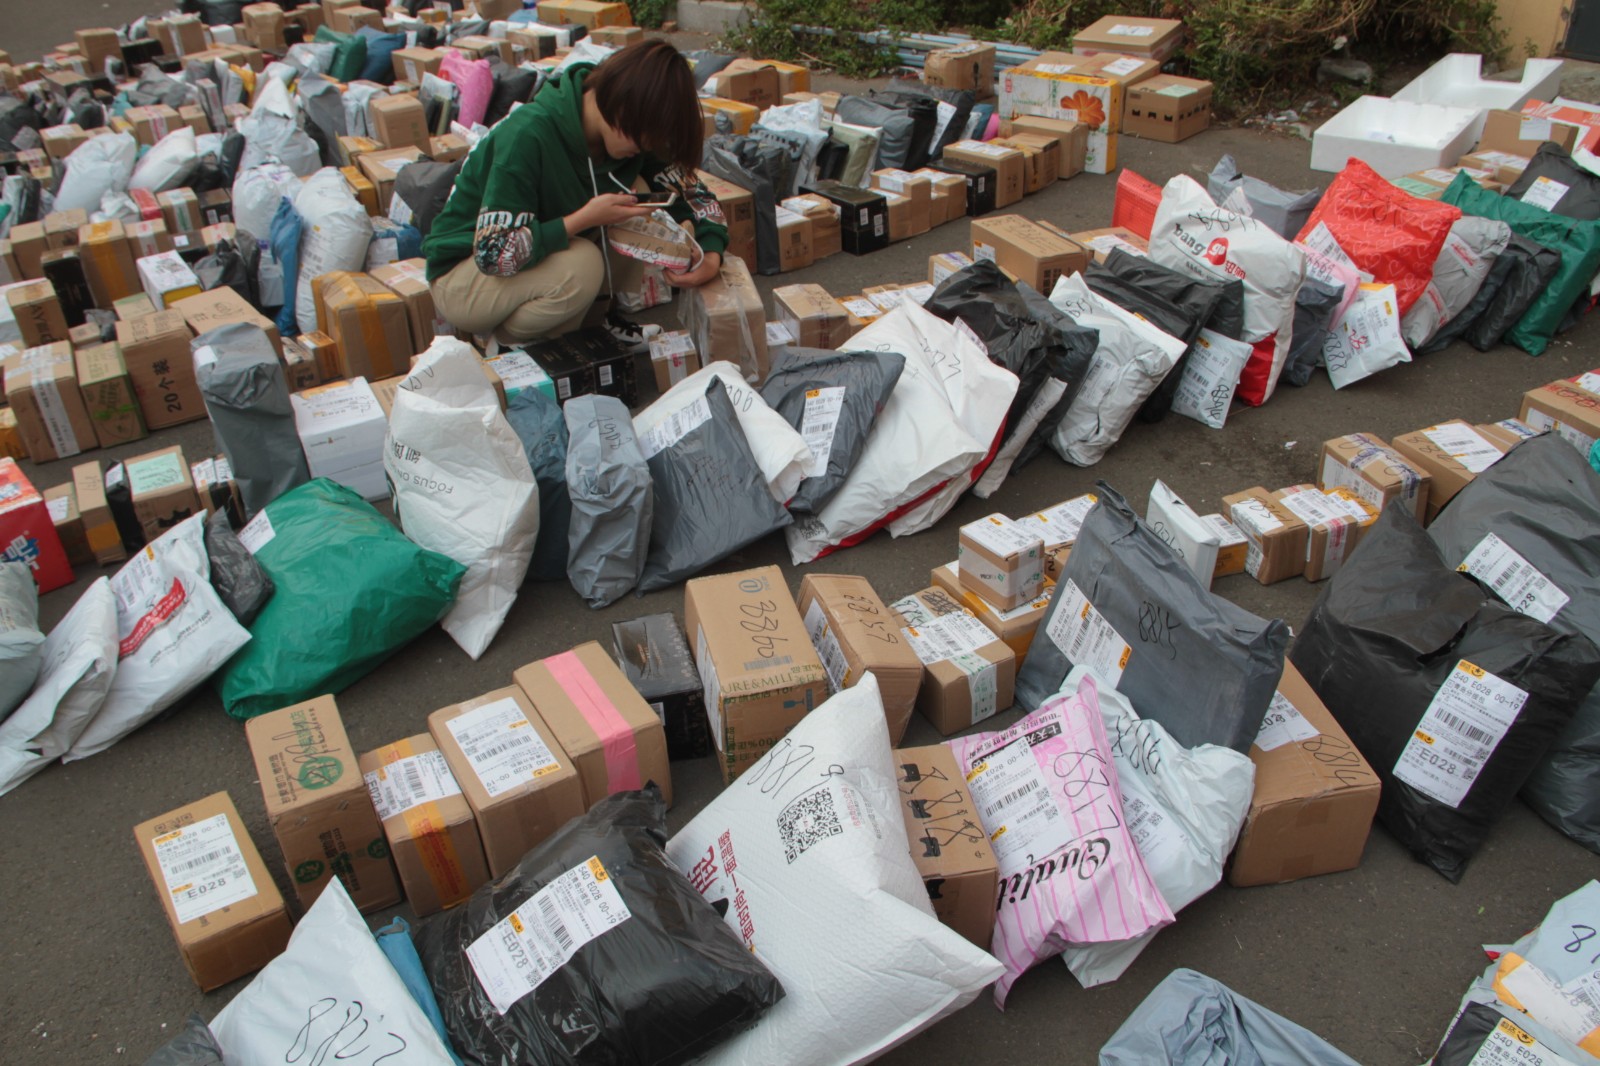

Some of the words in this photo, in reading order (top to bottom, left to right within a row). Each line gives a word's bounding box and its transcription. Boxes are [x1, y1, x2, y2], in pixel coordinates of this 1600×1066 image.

[1173, 222, 1206, 256] bang
[413, 475, 454, 494] FOCUS
[1515, 592, 1536, 614] 028
[1453, 672, 1470, 684] 540
[1471, 681, 1491, 696] E028
[1494, 692, 1520, 710] 00-19
[985, 763, 1004, 778] E028
[1006, 748, 1029, 765] 00-19
[1419, 748, 1457, 775] E028
[176, 831, 198, 843] E028
[201, 820, 226, 834] 00-19
[187, 878, 227, 899] E028
[997, 837, 1111, 911] Qualit
[577, 865, 591, 880] 540
[586, 880, 602, 901] E028
[598, 900, 617, 925] 00-19
[502, 930, 530, 970] E028
[1492, 1031, 1513, 1047] 540
[1515, 1044, 1543, 1066] E028
